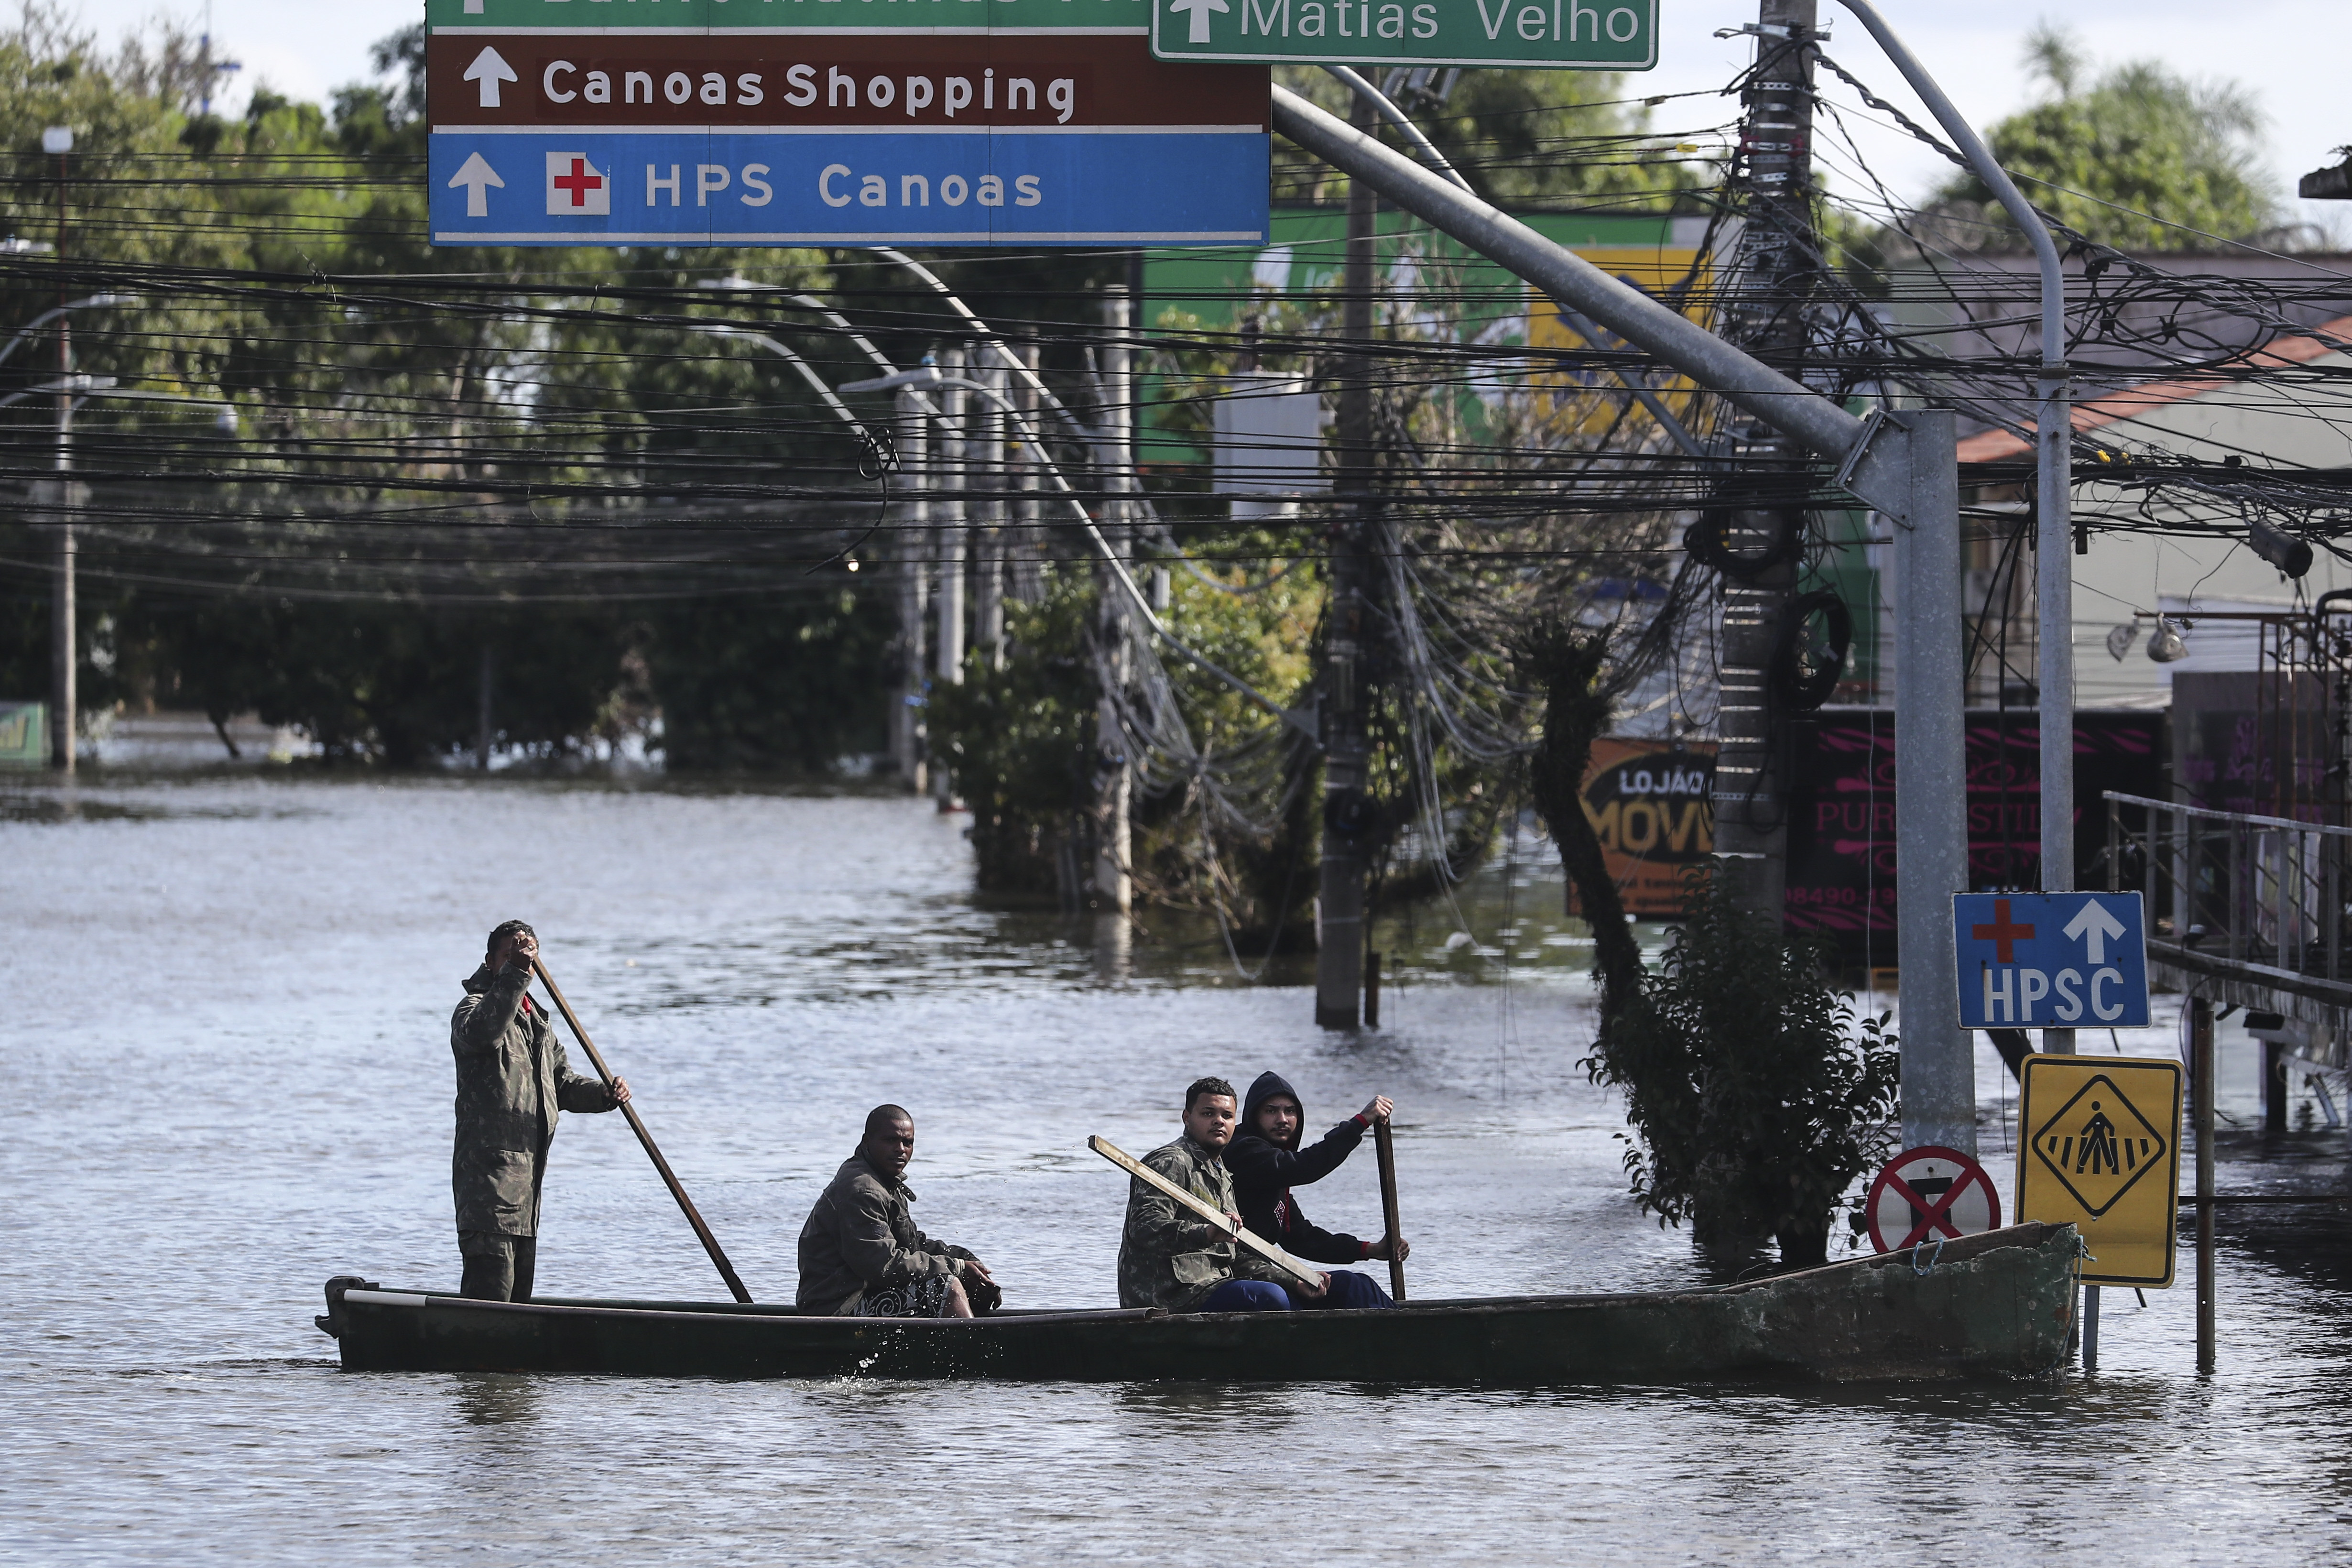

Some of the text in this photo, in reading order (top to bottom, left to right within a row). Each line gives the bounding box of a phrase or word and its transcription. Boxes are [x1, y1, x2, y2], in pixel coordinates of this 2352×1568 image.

[1241, 0, 1639, 42] Matias Velho
[543, 60, 1075, 125] Canoas Shopping
[646, 163, 1042, 207] HPS Canoas
[1984, 968, 2124, 1022] HPSC
